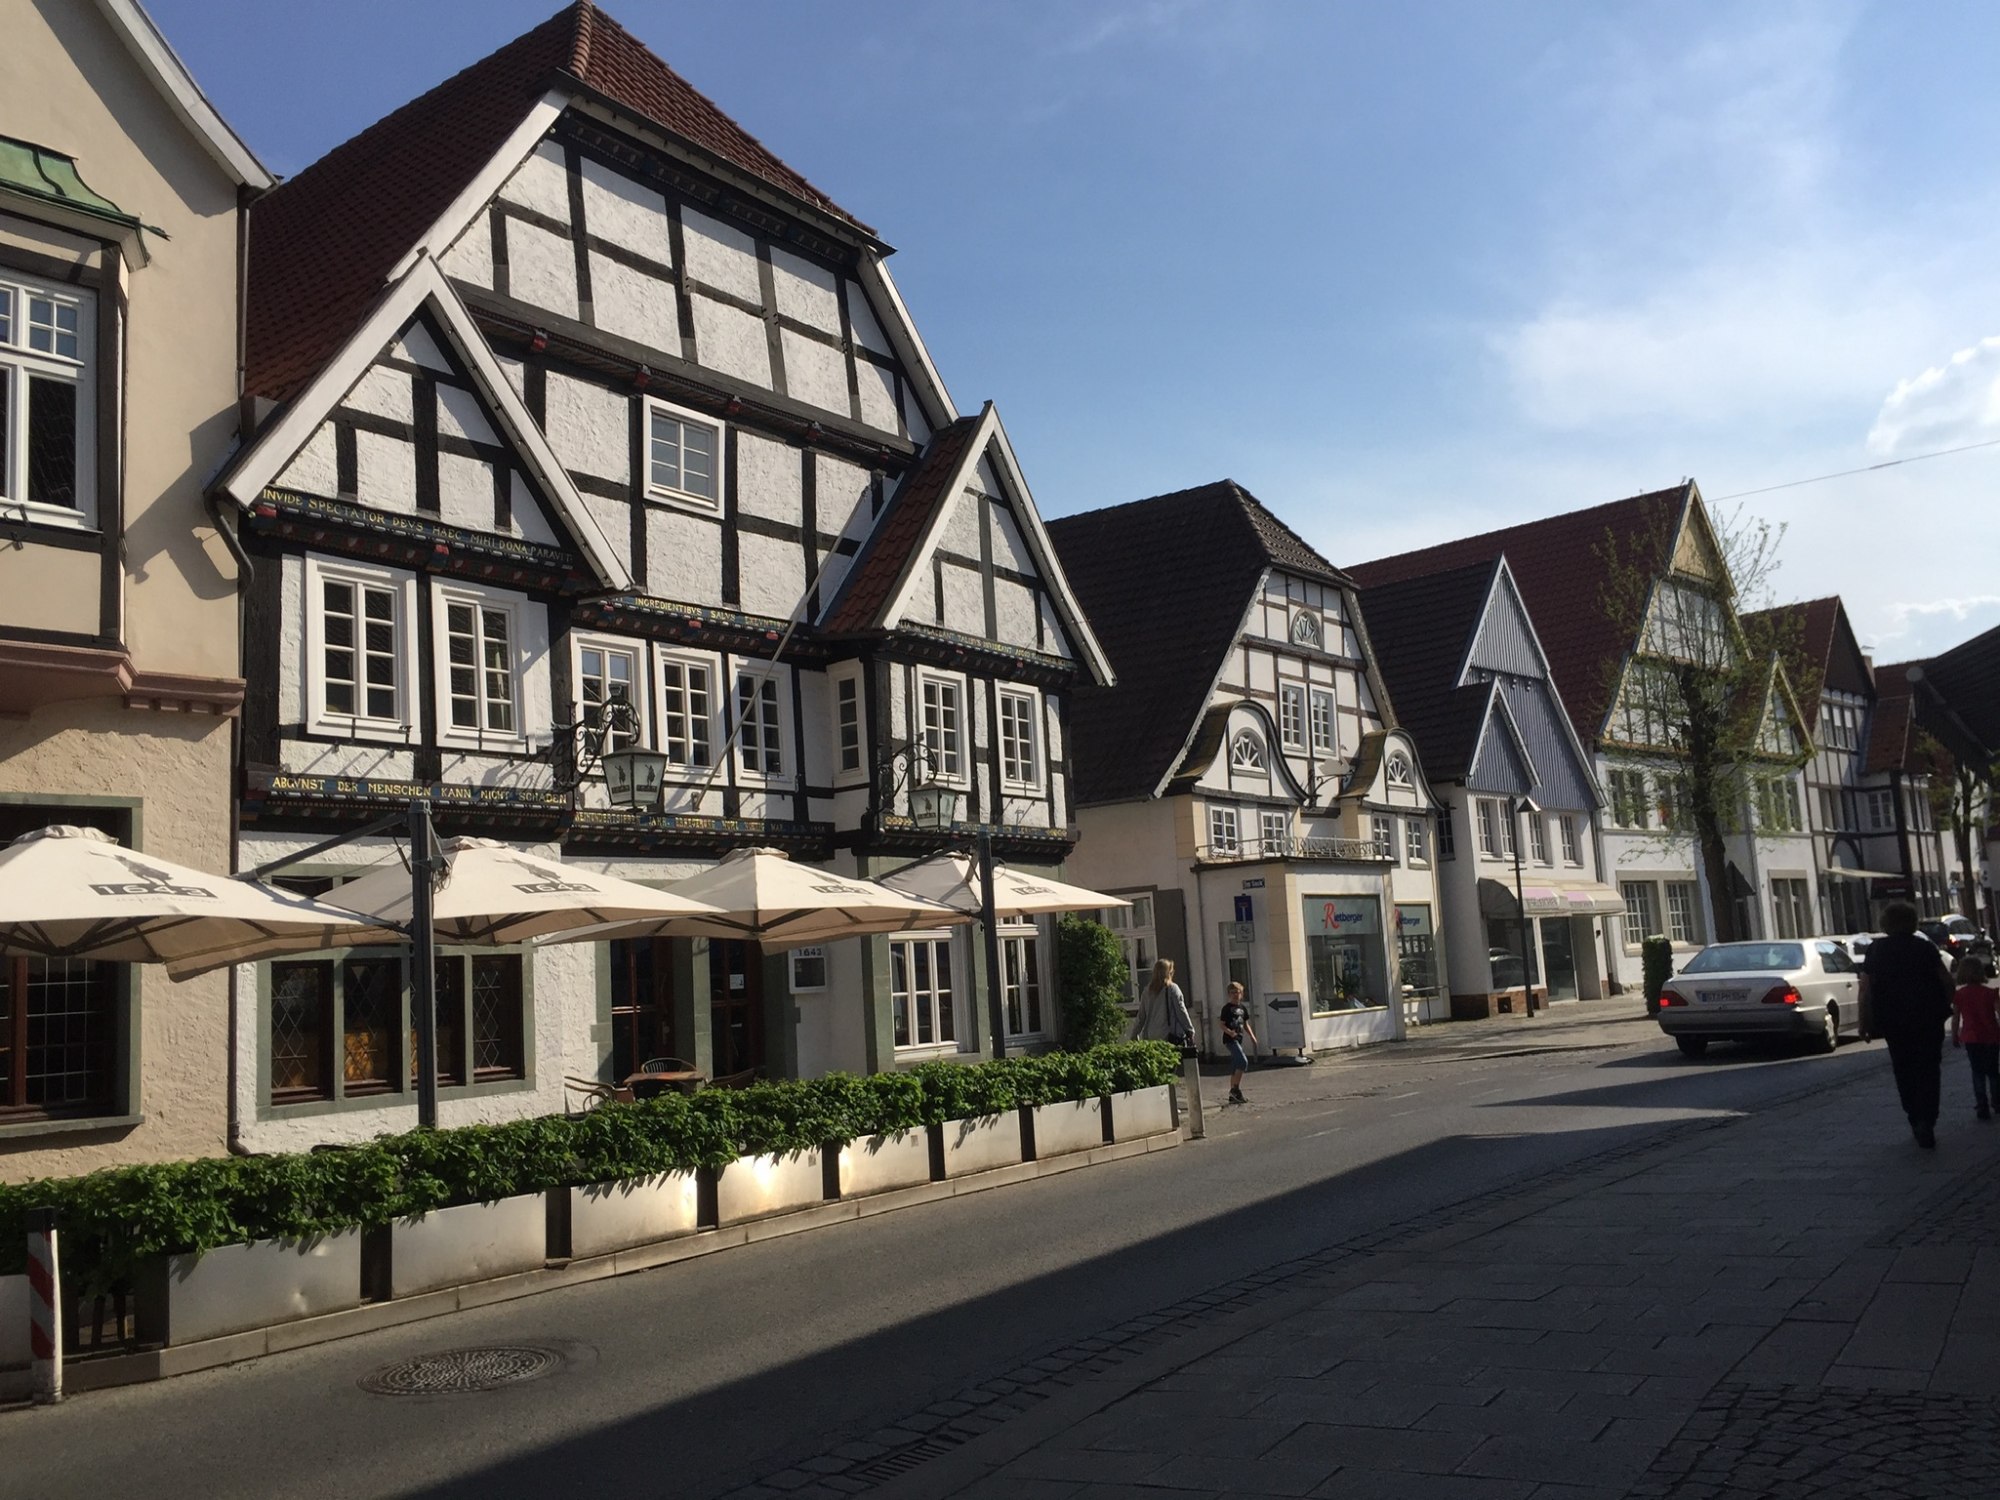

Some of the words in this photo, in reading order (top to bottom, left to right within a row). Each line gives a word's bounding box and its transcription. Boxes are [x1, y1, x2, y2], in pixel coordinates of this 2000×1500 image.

[263, 488, 303, 506] INVIDE
[308, 499, 386, 524] SPECTATOR
[392, 517, 424, 532] DEVS
[432, 525, 463, 540] HAEC
[499, 541, 528, 554] DONA
[635, 597, 702, 616] INGREDIENTIBVS
[337, 781, 359, 793] DER
[367, 783, 431, 797] MENSCHEN
[441, 787, 472, 799] KANN
[480, 789, 509, 800] NICHT
[97, 883, 209, 897] 1643
[519, 883, 594, 893] 1643
